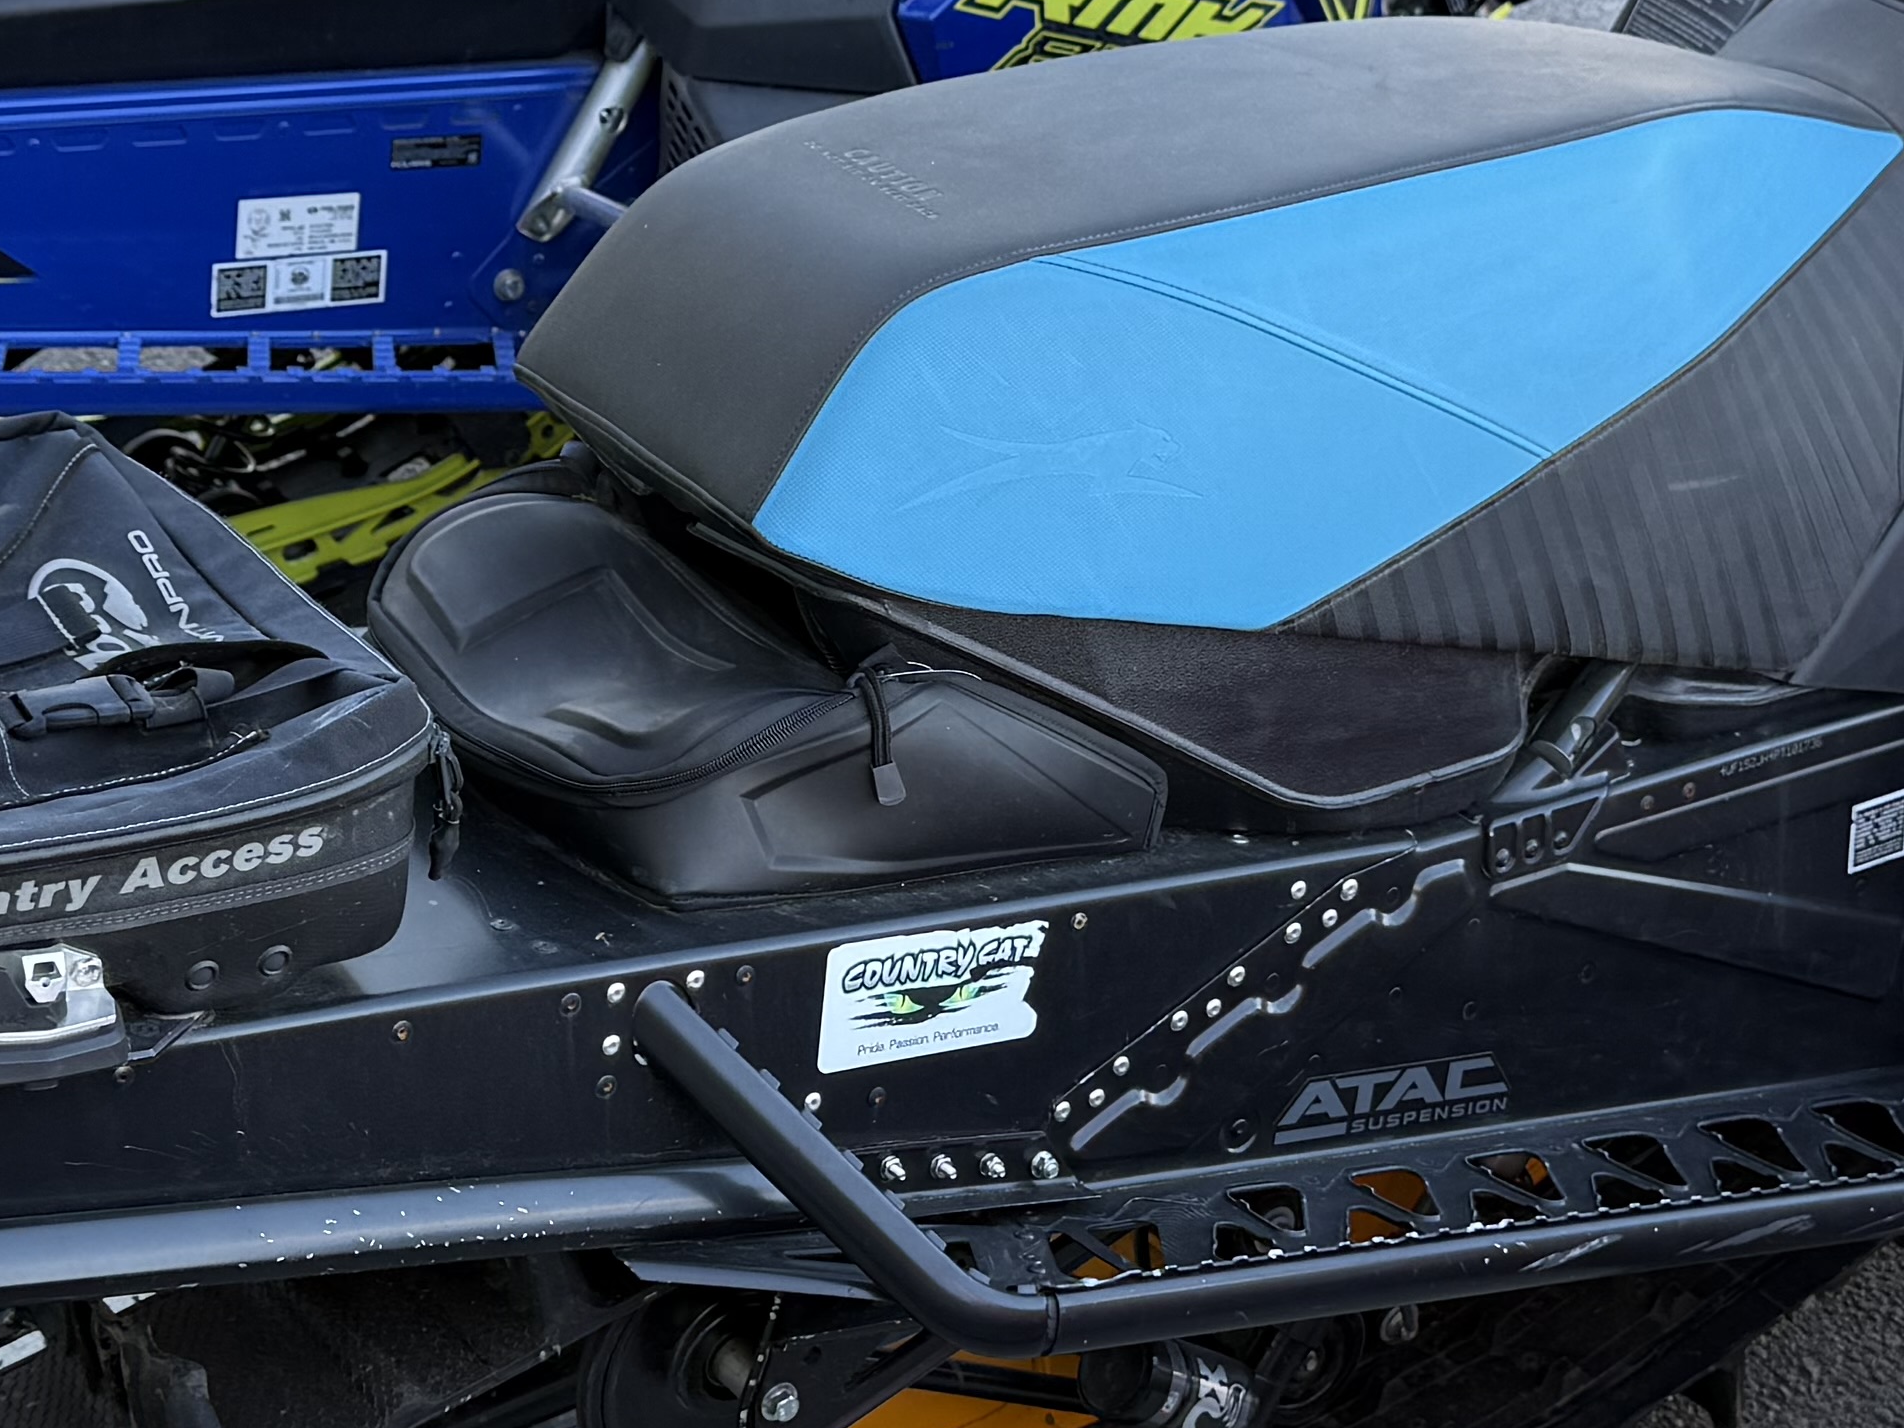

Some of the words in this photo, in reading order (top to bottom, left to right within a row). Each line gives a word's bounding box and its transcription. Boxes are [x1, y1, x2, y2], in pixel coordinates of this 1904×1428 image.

[119, 823, 326, 895] Access
[841, 940, 978, 994] COUNTRY
[1276, 1056, 1509, 1128] ATAC
[1349, 1096, 1508, 1133] SUSPENSION
